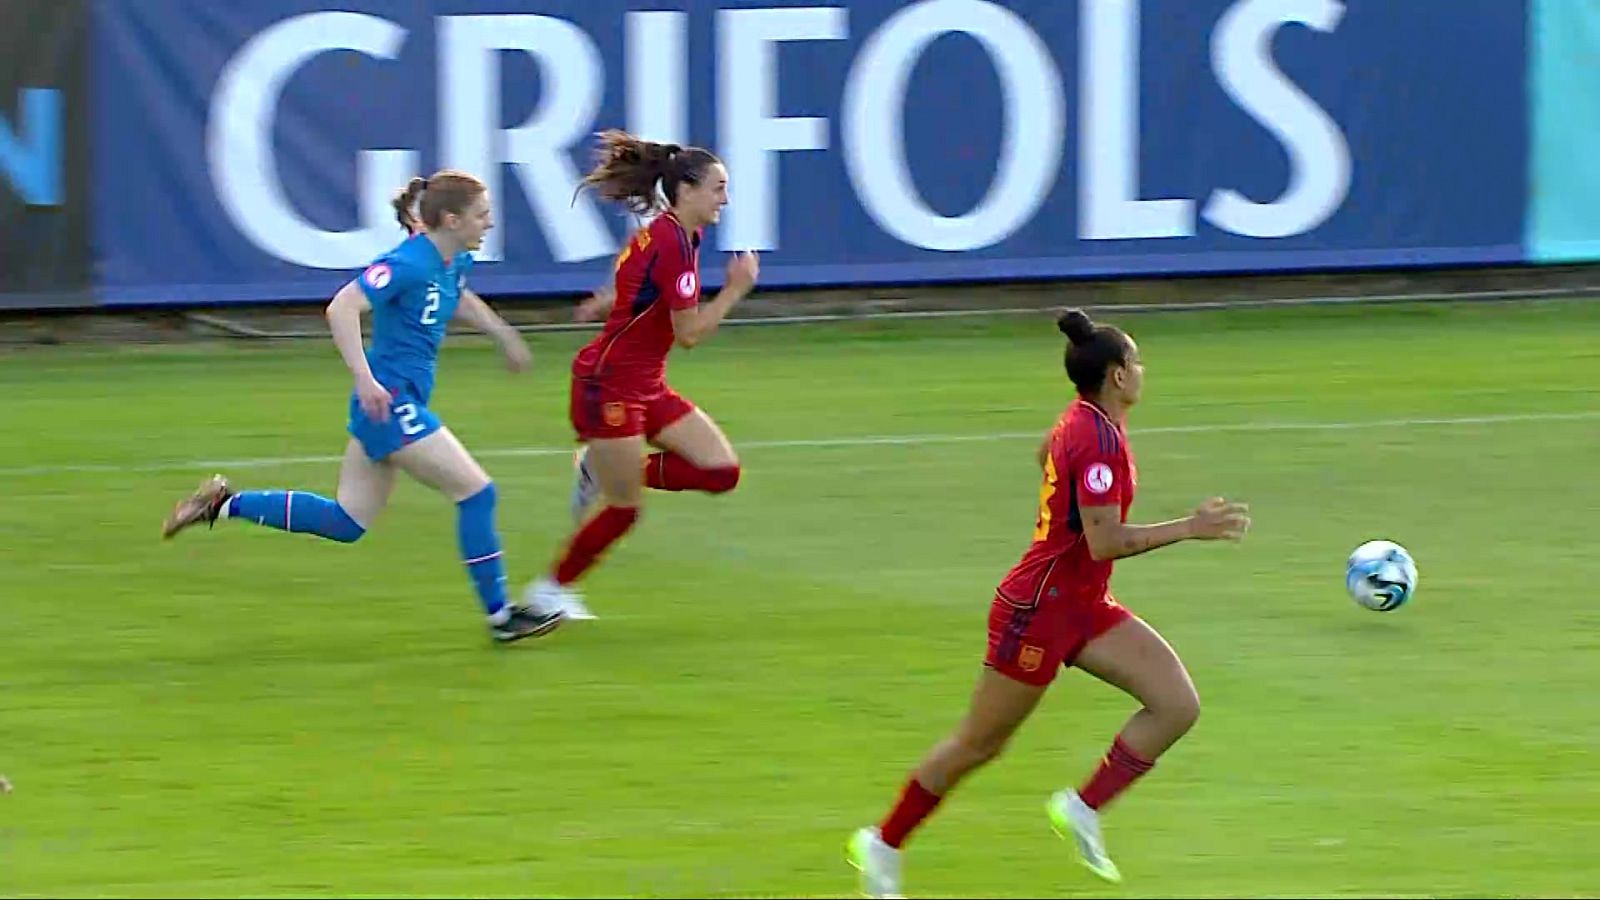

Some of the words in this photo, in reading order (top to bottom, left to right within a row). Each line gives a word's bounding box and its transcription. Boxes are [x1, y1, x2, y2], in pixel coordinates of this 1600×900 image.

[206, 0, 1352, 269] GRIFOLS
[419, 291, 440, 325] 2
[394, 403, 426, 435] 2
